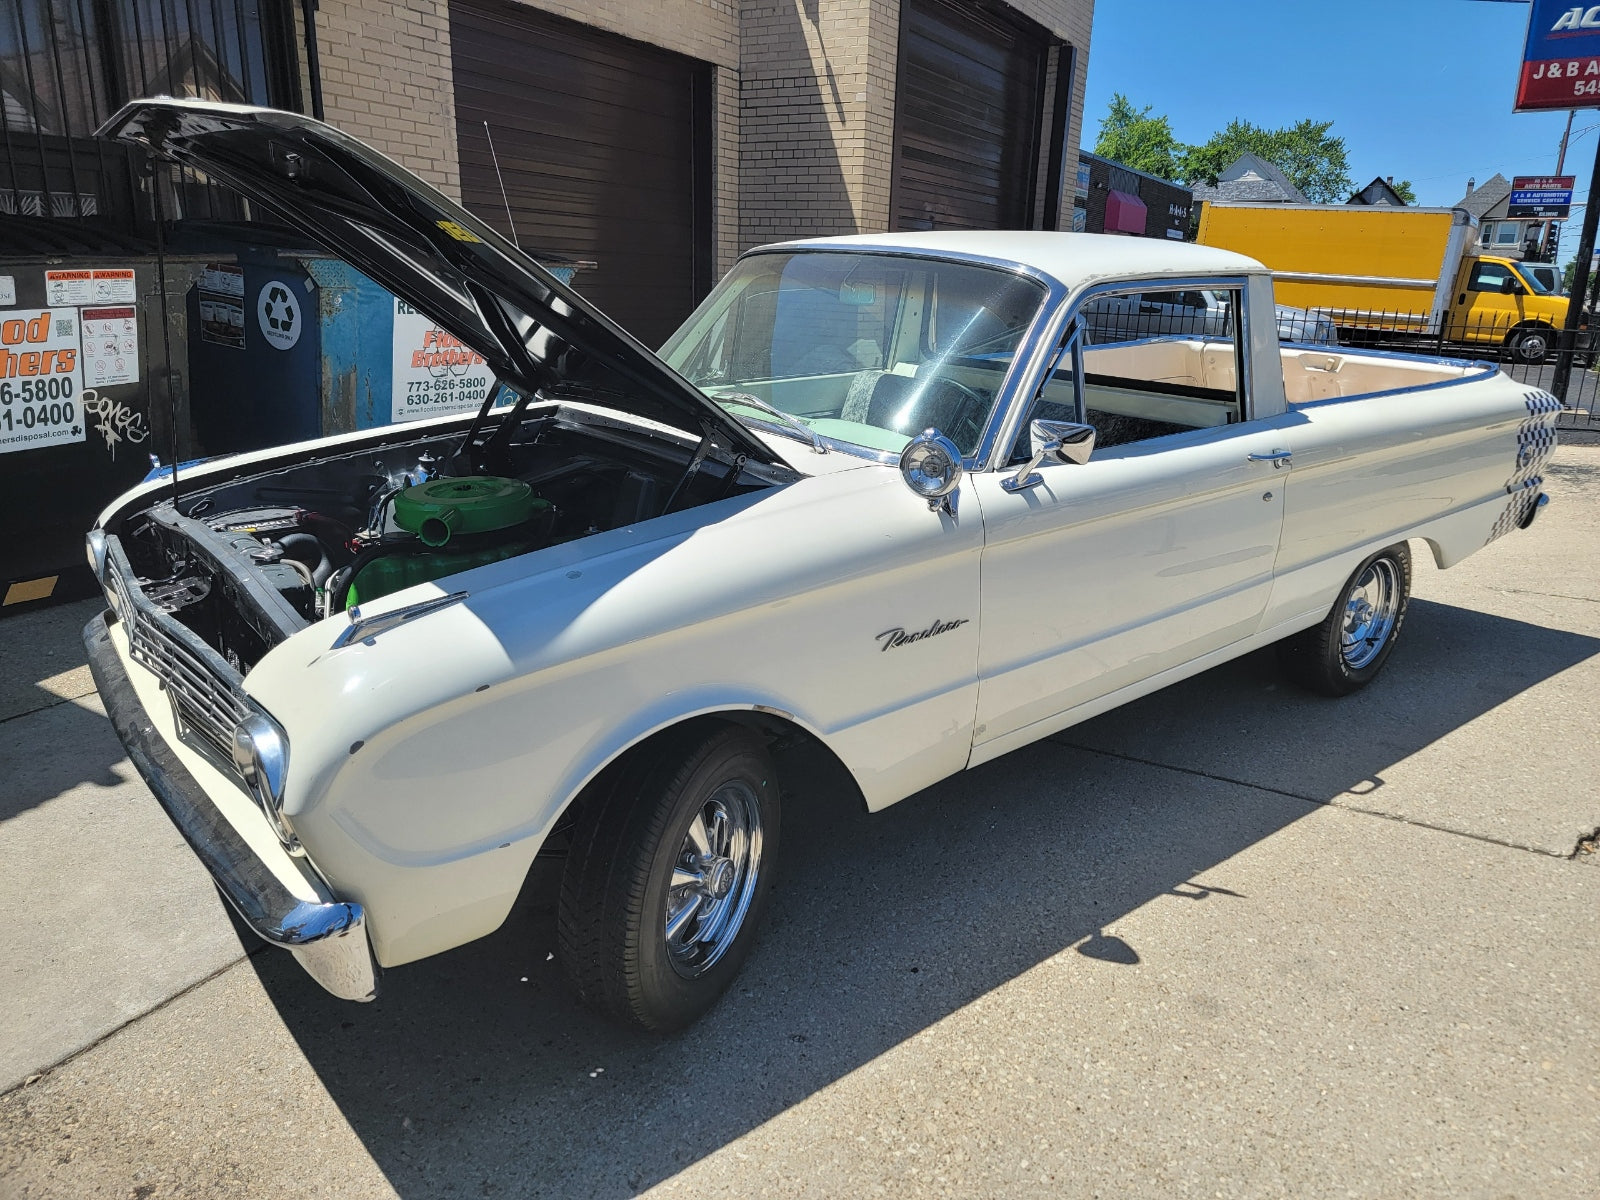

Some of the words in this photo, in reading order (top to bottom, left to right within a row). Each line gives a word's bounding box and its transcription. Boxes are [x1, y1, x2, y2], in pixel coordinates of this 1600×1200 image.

[1533, 64, 1545, 79] J
[1547, 62, 1563, 78] &
[1566, 61, 1580, 76] B
[1584, 60, 1600, 76] A
[1573, 80, 1600, 96] 54
[0, 312, 51, 345] od
[411, 349, 484, 368] Brothers
[0, 377, 73, 405] 6-5800
[407, 377, 486, 393] 773-626-5800
[406, 389, 486, 406] 630-261-0400
[0, 402, 75, 431] 1-0400
[0, 429, 69, 444] ersdisposal.com
[875, 619, 970, 652] Ranchero
